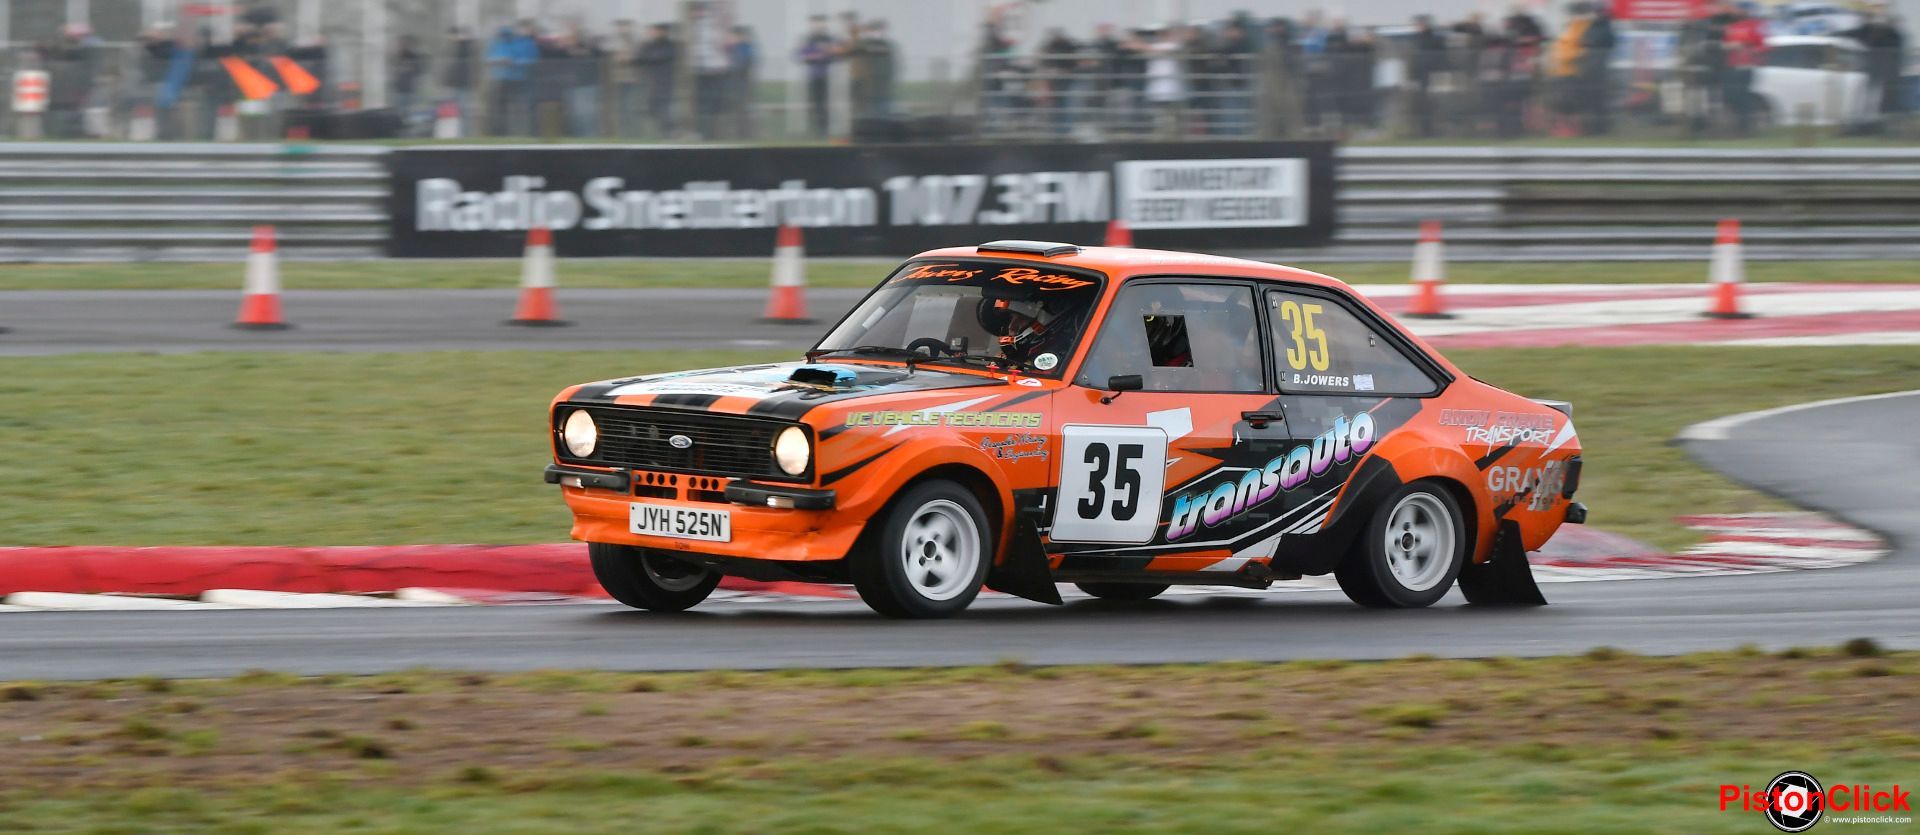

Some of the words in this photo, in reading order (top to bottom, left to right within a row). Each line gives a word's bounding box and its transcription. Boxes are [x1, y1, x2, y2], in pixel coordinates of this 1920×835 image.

[415, 176, 582, 231] Radio
[583, 175, 878, 231] Snetterton
[883, 171, 1110, 227] 107.3FM
[989, 268, 1096, 290] Racing
[1280, 300, 1330, 371] 35
[1293, 374, 1349, 386] B.JOWERS
[873, 411, 941, 426] VEHICLE
[943, 412, 1042, 427] TECHNICIANS
[1466, 425, 1556, 457] TRANSPORT
[1077, 442, 1144, 521] 35
[1166, 410, 1377, 542] transauto
[637, 507, 670, 532] JYH
[675, 511, 722, 537] 525N
